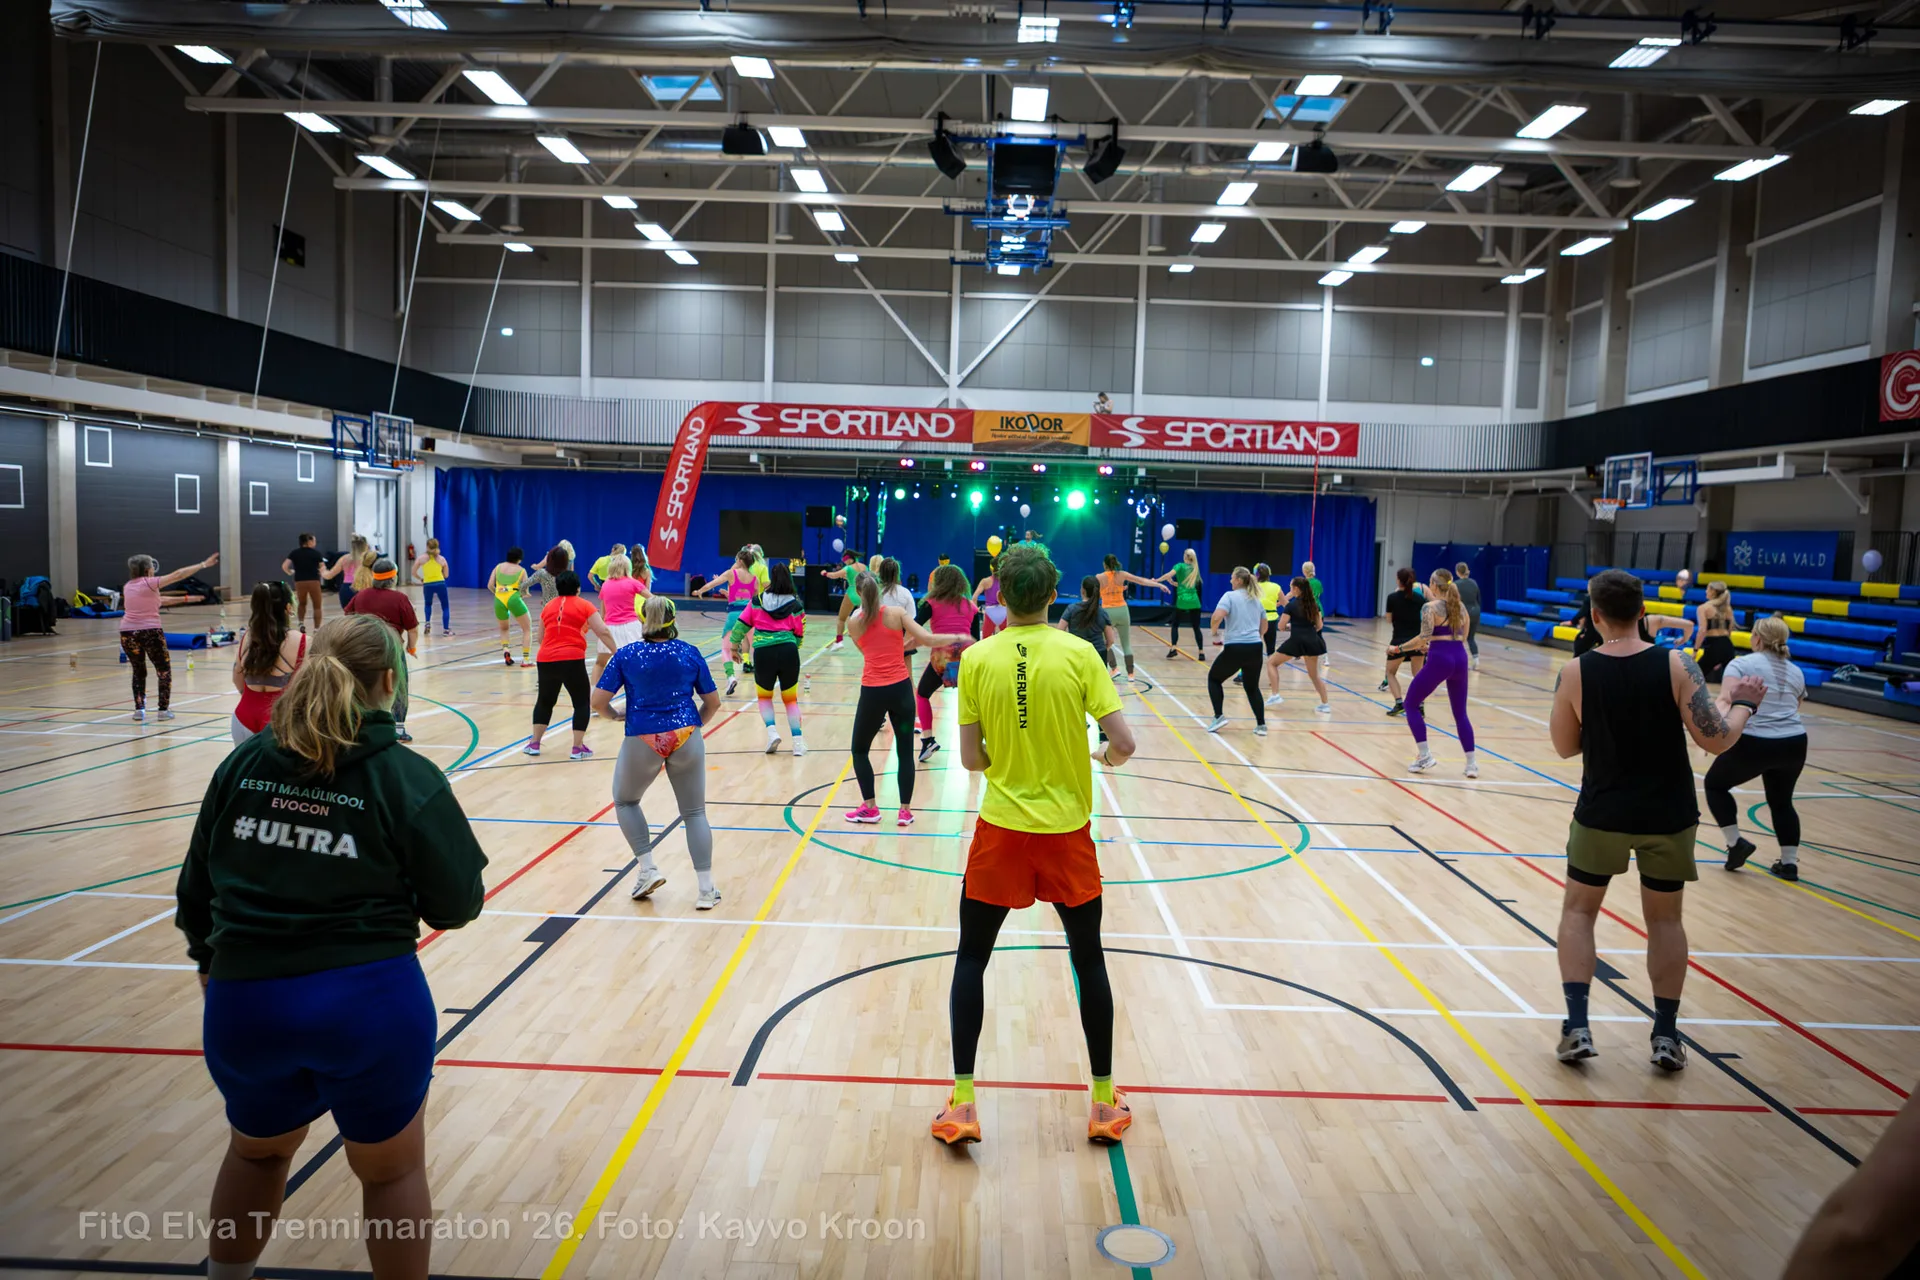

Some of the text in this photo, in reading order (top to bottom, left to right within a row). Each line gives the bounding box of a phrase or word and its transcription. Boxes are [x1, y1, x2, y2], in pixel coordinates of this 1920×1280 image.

[779, 407, 955, 438] SPORTLAND
[1000, 413, 1063, 432] IKODOR
[1163, 421, 1340, 452] SPORTLAND
[666, 416, 705, 520] SPORTLAND
[1757, 547, 1787, 566] ELVA
[239, 778, 366, 811] EESTI MAAÜLIKOOL
[271, 797, 330, 817] EVOCON
[232, 815, 359, 859] #ULTRA
